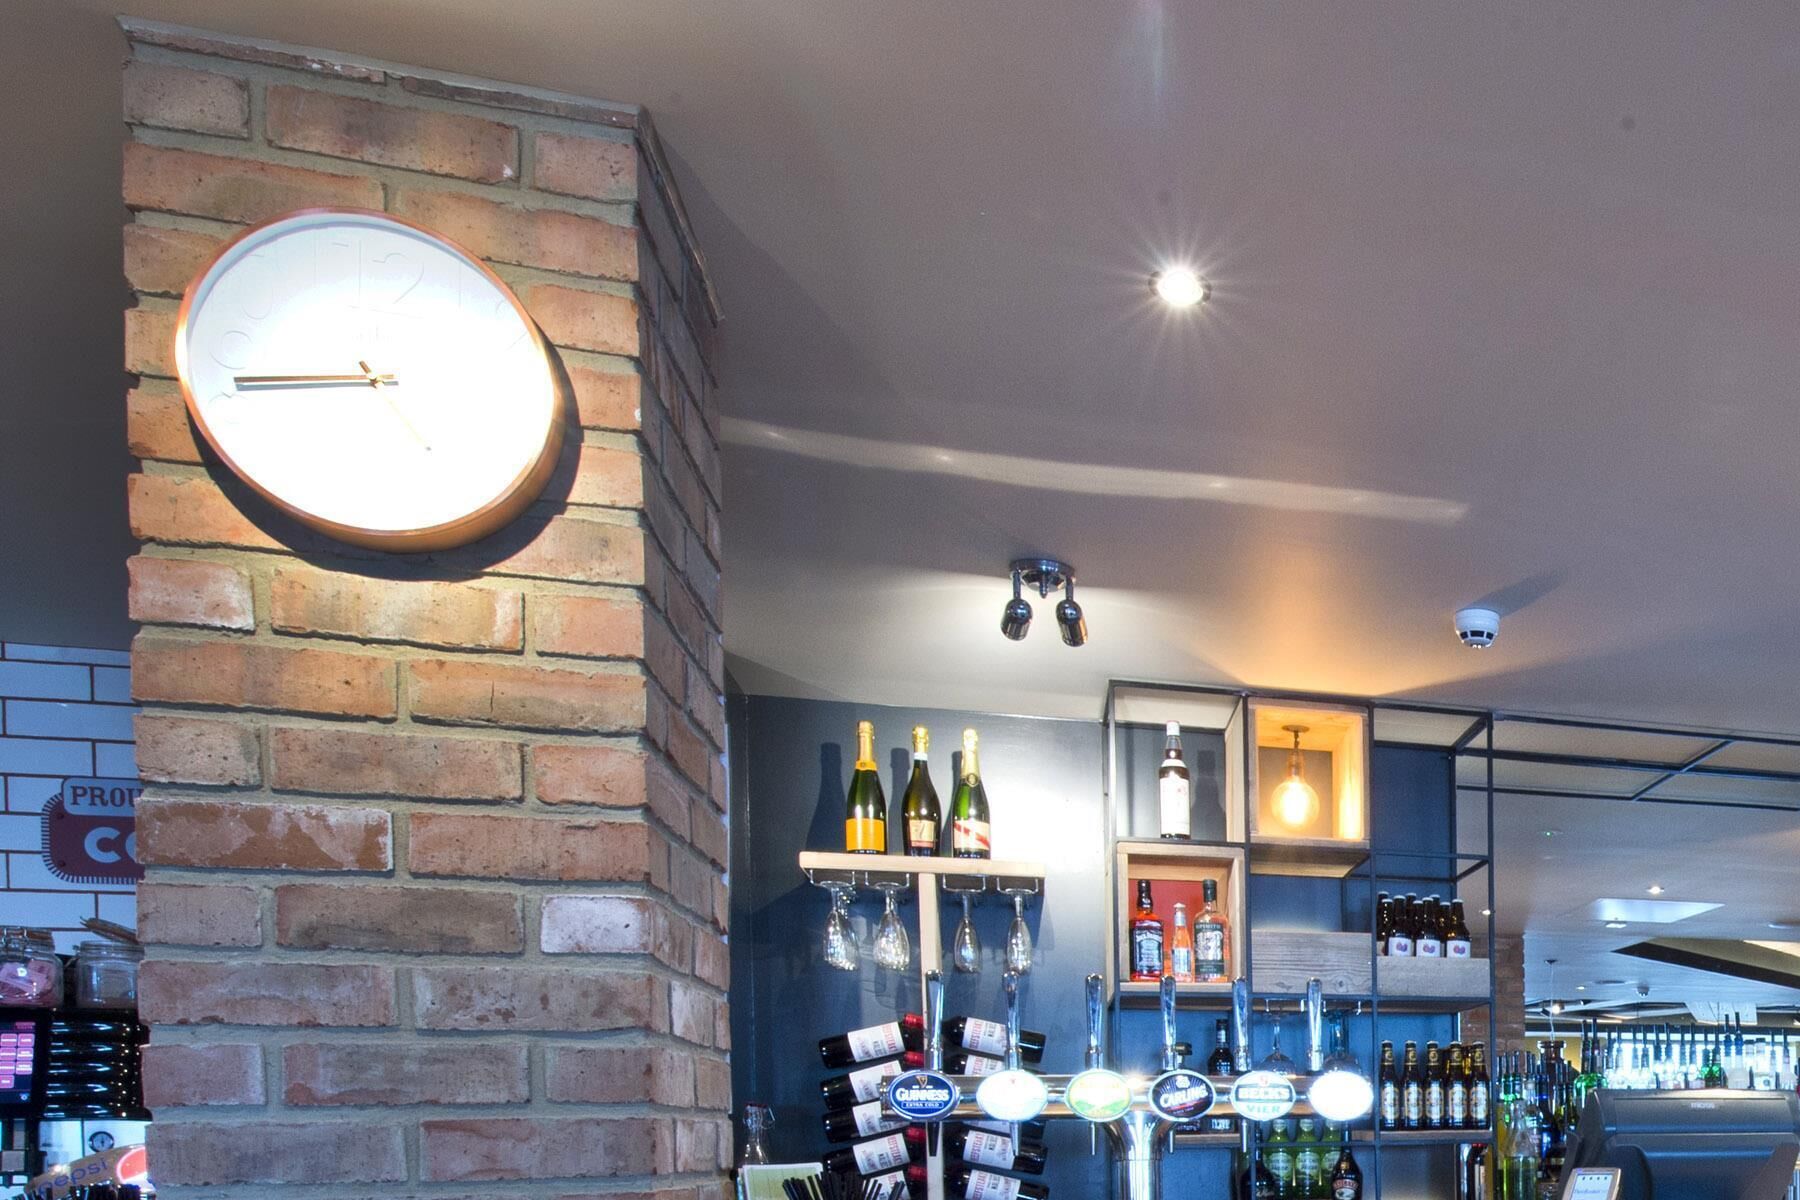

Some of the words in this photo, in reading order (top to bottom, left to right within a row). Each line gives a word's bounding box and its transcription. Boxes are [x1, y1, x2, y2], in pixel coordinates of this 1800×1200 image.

[895, 1087, 950, 1102] GUINNESS
[1159, 1083, 1209, 1108] CARLING
[1246, 1104, 1281, 1113] VIER
